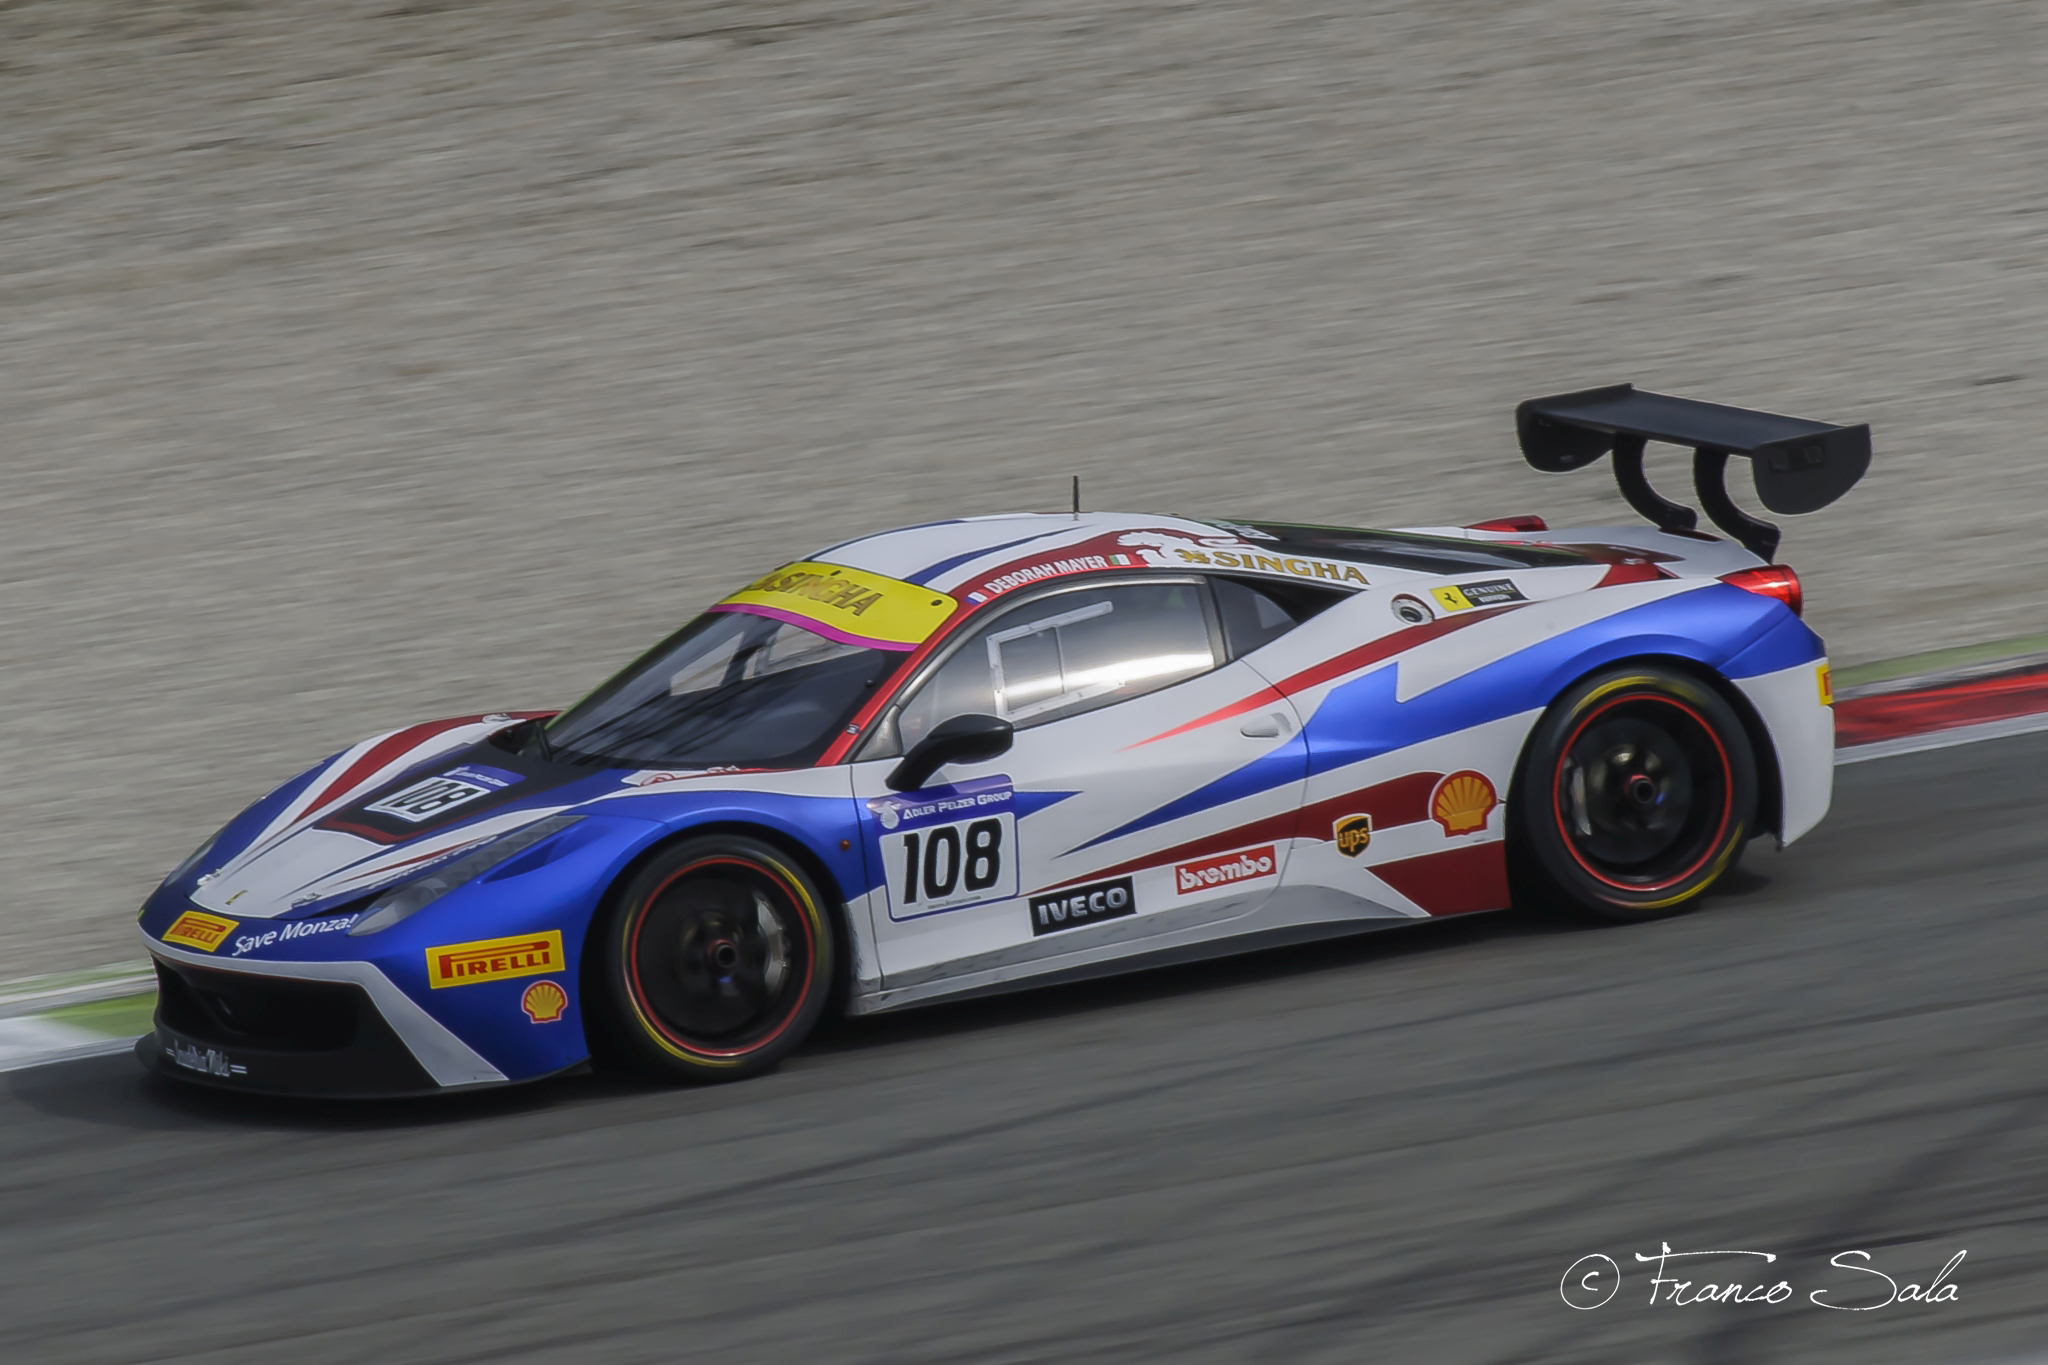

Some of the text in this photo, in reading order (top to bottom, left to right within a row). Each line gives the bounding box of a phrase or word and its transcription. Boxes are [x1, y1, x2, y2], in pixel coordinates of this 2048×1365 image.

[984, 555, 1109, 594] DEBORAH MAYER
[1214, 551, 1371, 585] SINGHA
[902, 817, 1002, 904] 108
[1178, 853, 1273, 891] brembo
[1037, 887, 1128, 925] IVECO
[169, 917, 227, 944] PIRELLI
[232, 913, 359, 956] Save Monza!
[438, 940, 550, 979] PIRELLI
